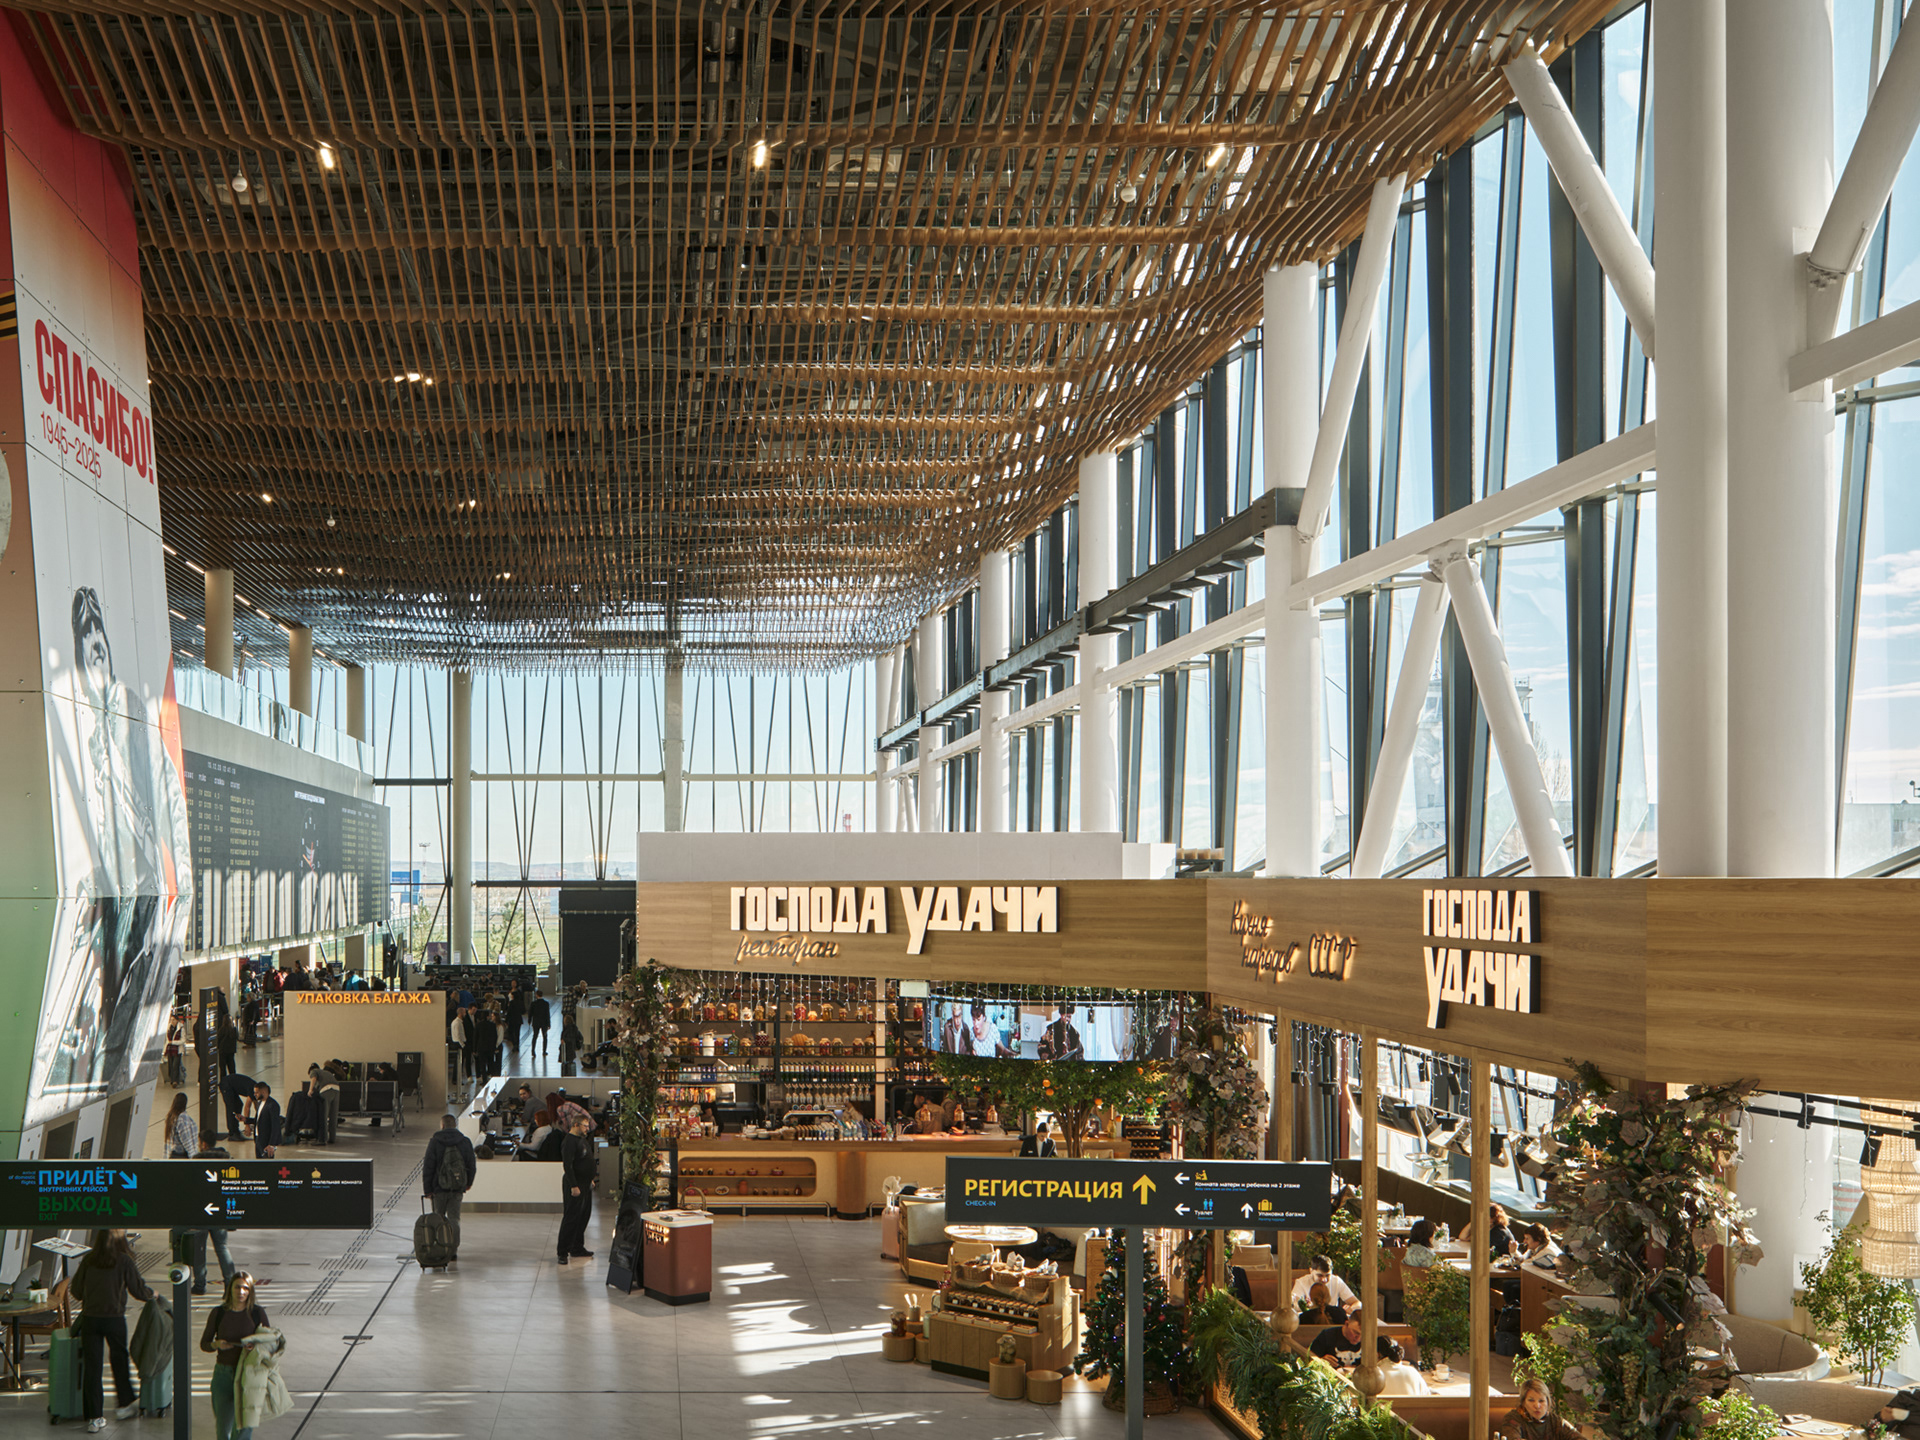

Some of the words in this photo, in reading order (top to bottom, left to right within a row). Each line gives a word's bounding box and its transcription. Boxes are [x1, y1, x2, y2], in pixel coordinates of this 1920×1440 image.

[34, 318, 154, 485] СПАСИБО!
[730, 886, 889, 934] ГОСПОДА
[900, 886, 1058, 955] УДАЧИ
[1230, 899, 1274, 947] Кухня
[1423, 889, 1533, 943] ГОСПОДА
[733, 933, 839, 966] ресторан
[1308, 932, 1359, 981] СССР
[296, 992, 371, 1004] УПАКОВКА
[373, 992, 432, 1004] БАГАЖА
[1423, 946, 1533, 1029] УДАЧИ
[38, 1167, 117, 1185] ПРИЛЁТ
[83, 1185, 109, 1193] РЕЙСОВ
[965, 1179, 1123, 1203] РЕГИСТРАЦИЯ
[38, 1196, 112, 1216] ВЫХОД
[38, 1213, 58, 1221] EXIT
